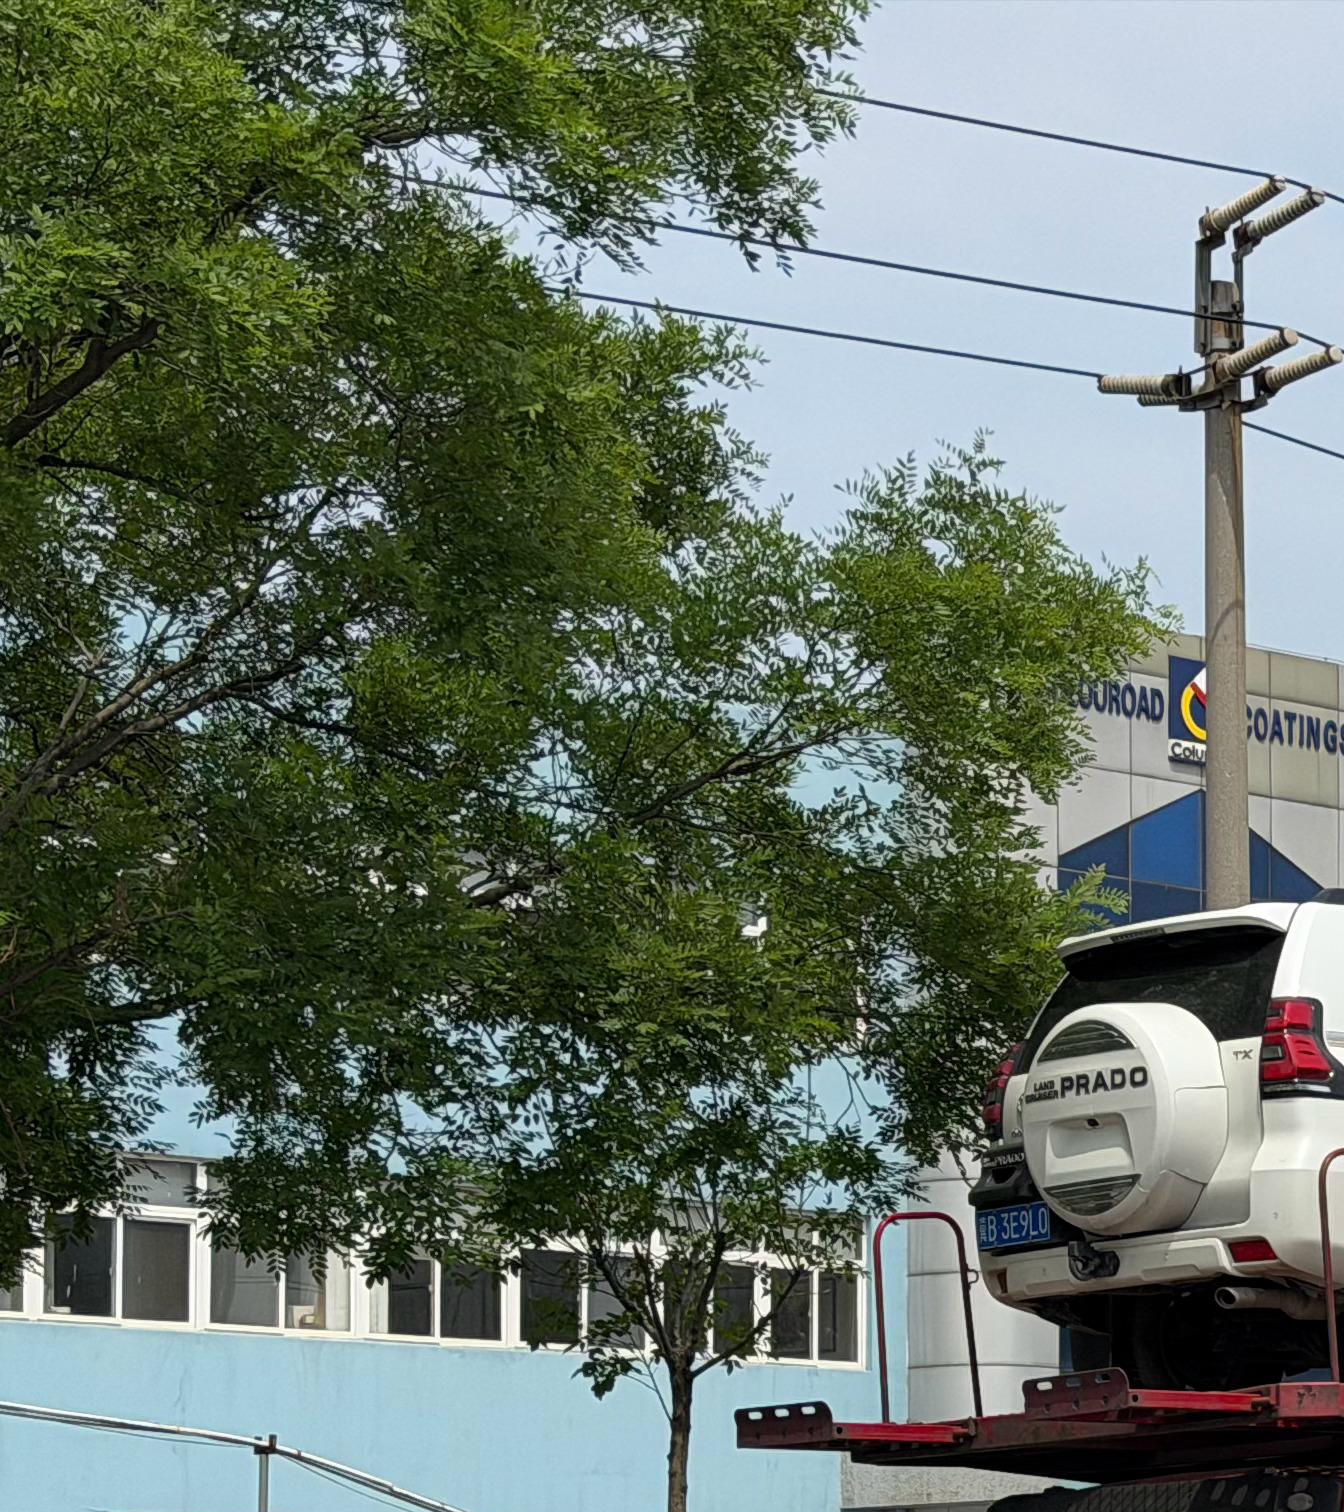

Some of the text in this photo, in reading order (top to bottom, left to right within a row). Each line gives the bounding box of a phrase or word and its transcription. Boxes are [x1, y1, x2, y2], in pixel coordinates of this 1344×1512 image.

[1070, 678, 1165, 723] OUROAD
[1171, 741, 1207, 761] Colu
[1060, 1066, 1148, 1099] PRADO
